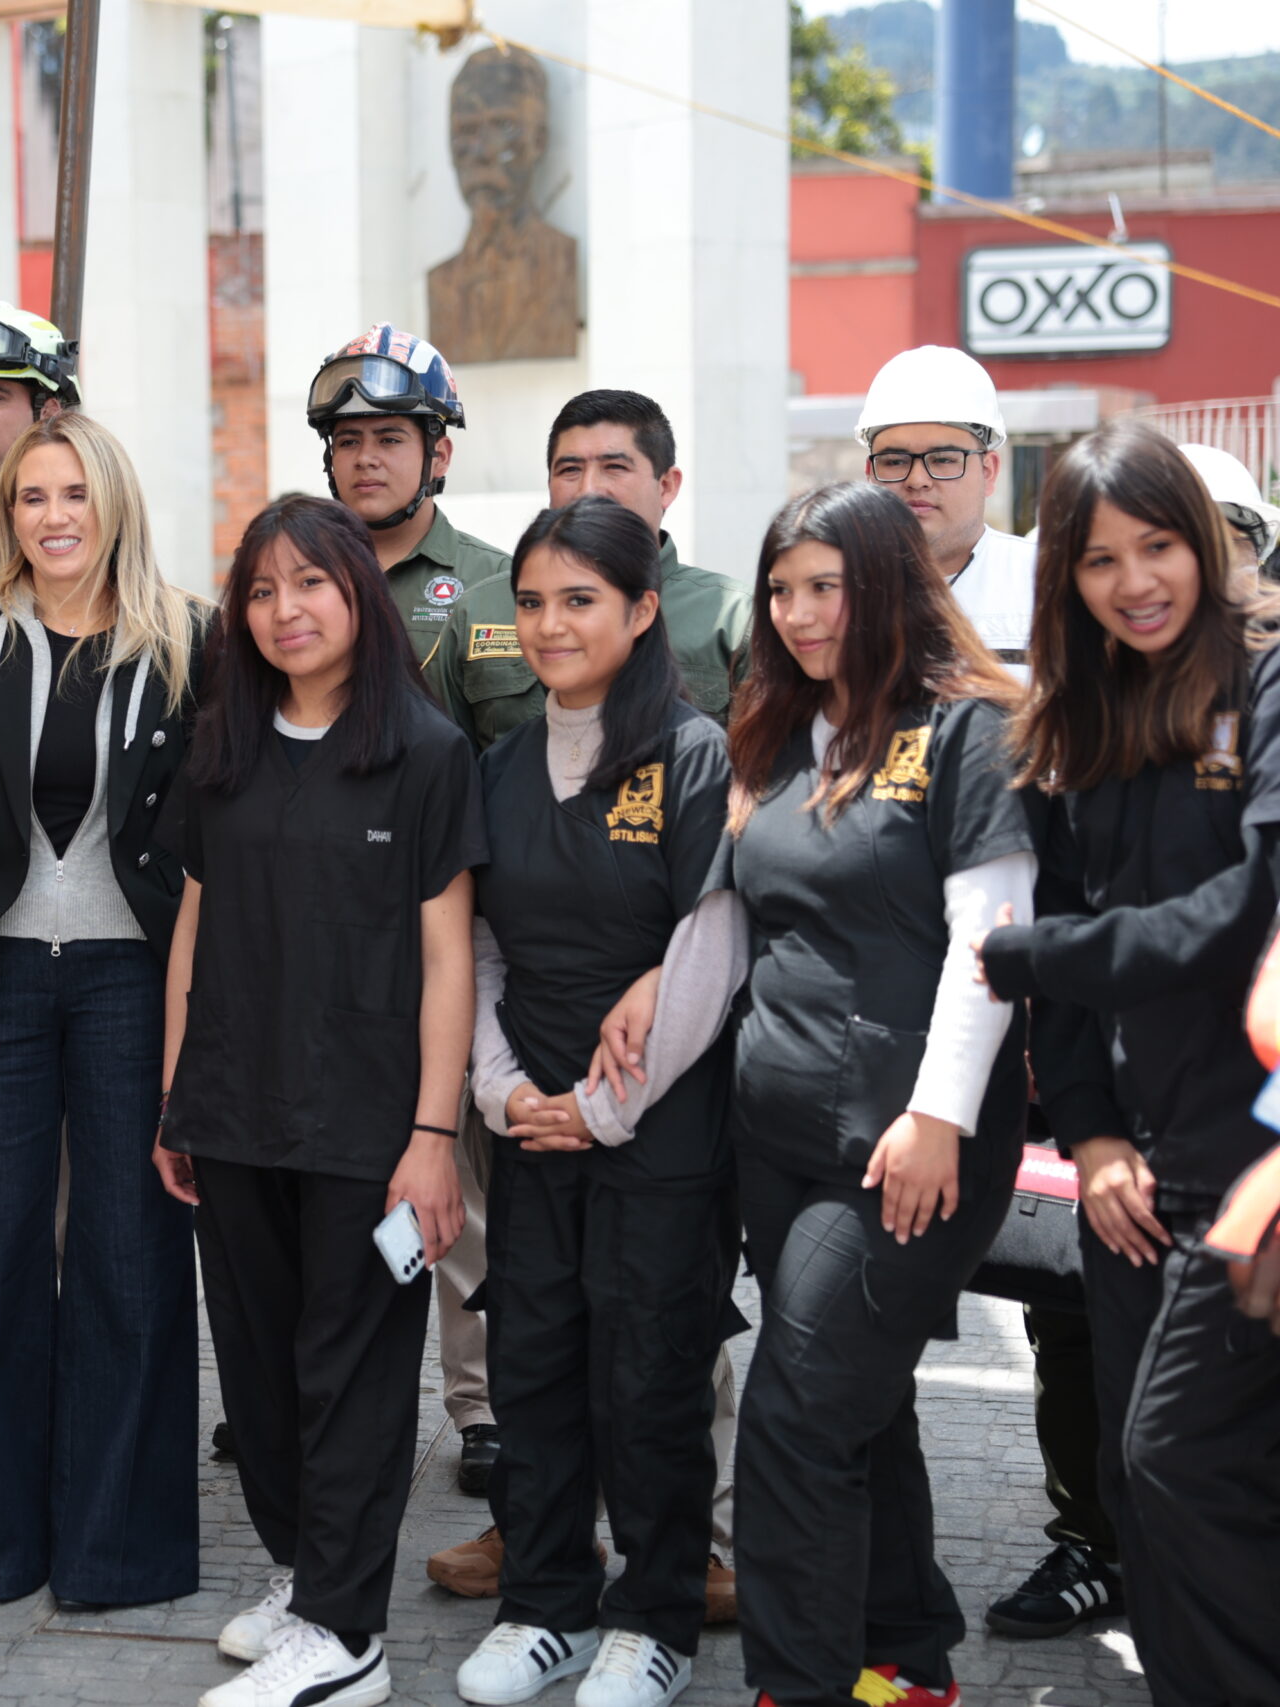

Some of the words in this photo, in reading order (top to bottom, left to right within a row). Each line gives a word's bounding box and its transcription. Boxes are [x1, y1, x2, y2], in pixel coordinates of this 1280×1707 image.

[979, 263, 1158, 334] OXXO
[475, 640, 521, 648] COORDINAD
[609, 828, 659, 845] ESTILISMO
[1022, 1159, 1077, 1181] HUSK
